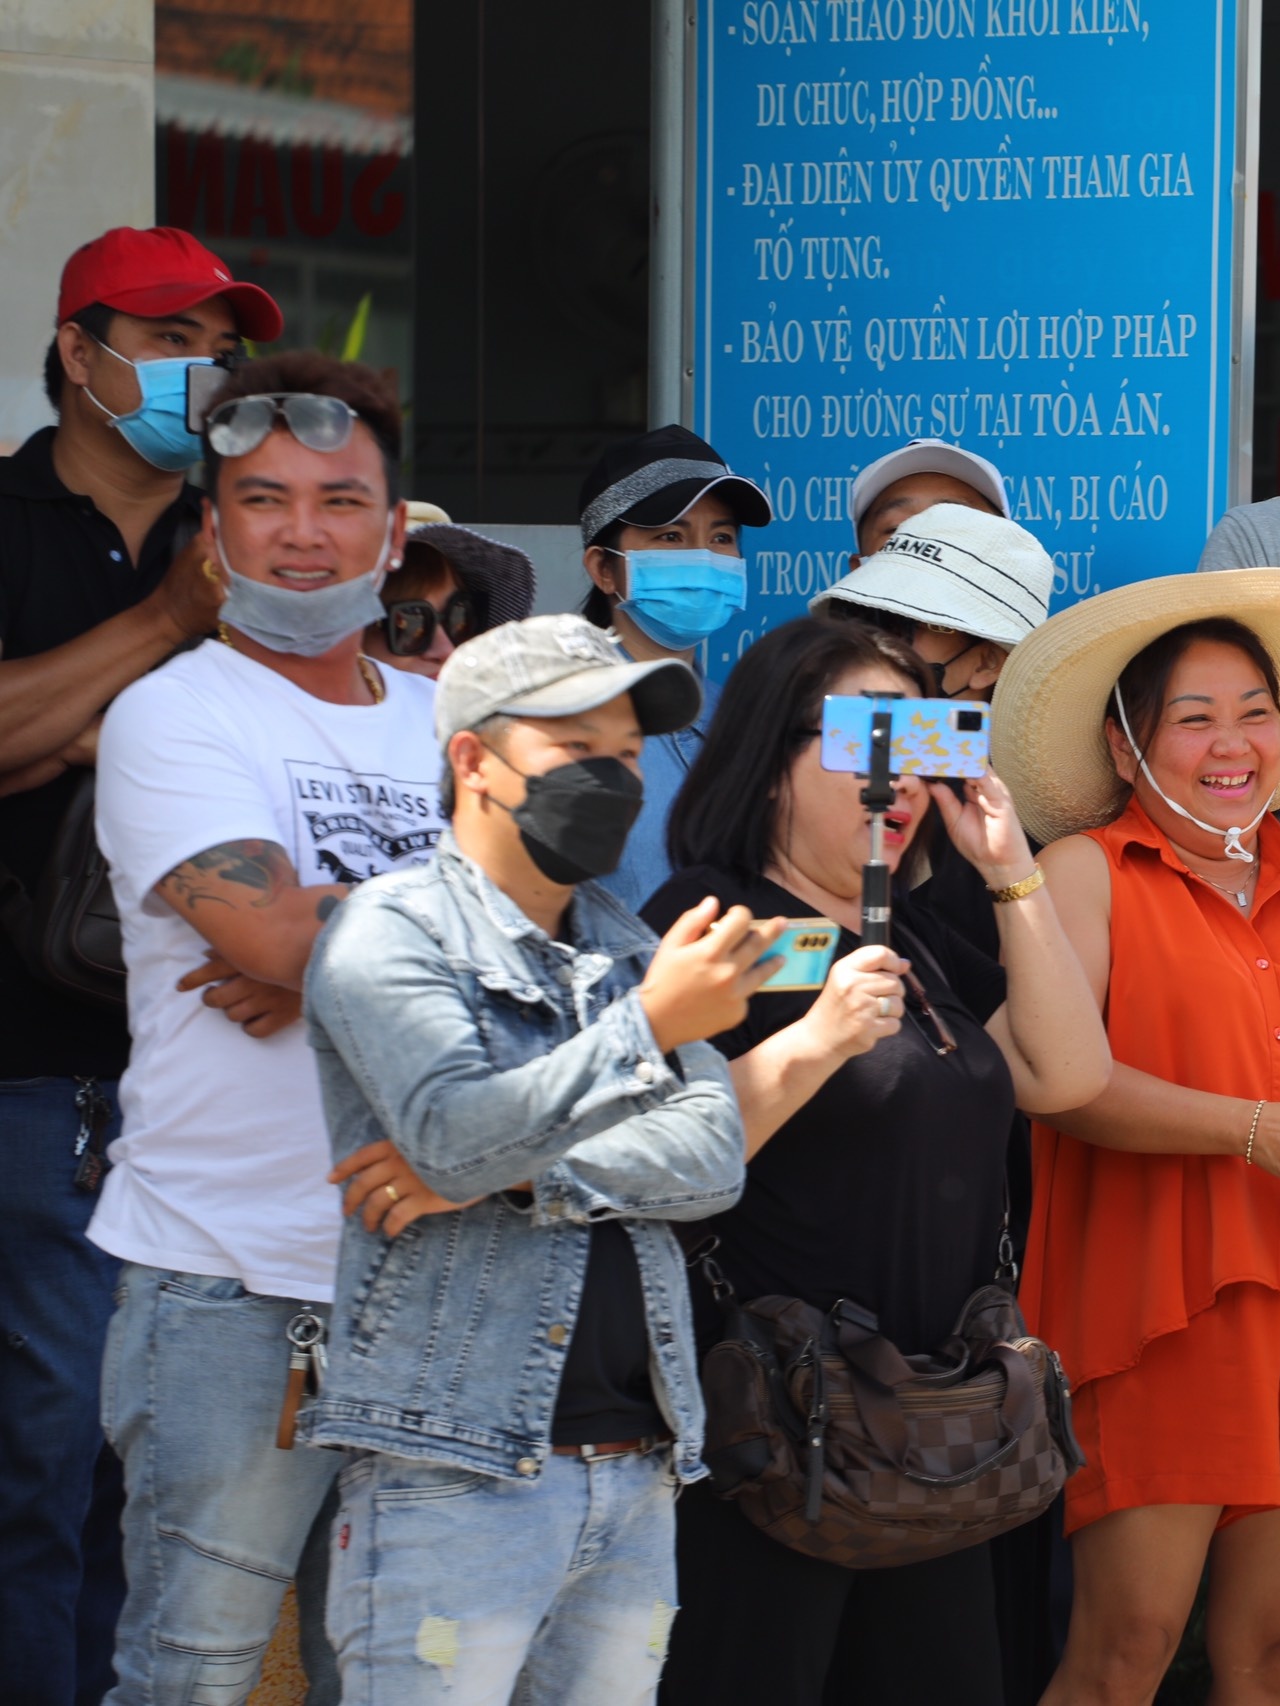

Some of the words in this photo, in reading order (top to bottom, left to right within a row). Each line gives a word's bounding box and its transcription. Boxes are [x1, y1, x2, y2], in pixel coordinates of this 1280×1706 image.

[744, 0, 818, 56] SOẠN
[757, 84, 786, 126] DI
[794, 68, 876, 132] CHÚC,
[881, 72, 944, 135] HỢP
[951, 55, 1057, 121] ĐỒNG...
[742, 163, 793, 218] ĐẠI
[801, 147, 873, 216] DIỆN
[882, 140, 922, 203] ỦY
[929, 135, 1034, 212] QUYỀN
[1043, 155, 1130, 198] THAM
[1138, 153, 1194, 197] GIA
[755, 217, 794, 280] TỐ
[801, 236, 890, 291] TỤNG.
[741, 302, 803, 362] BẢO
[811, 306, 852, 374] VỆ
[865, 296, 969, 371] QUYỀN
[978, 310, 1029, 373] LỢI
[1038, 309, 1103, 372] HỢP
[1112, 300, 1197, 358] PHÁP
[753, 395, 812, 438] CHO
[822, 389, 923, 438] ĐƯƠNG
[930, 388, 970, 448] SỰ
[975, 394, 1023, 449] TẠI
[1031, 380, 1102, 437] TÒA
[1109, 379, 1170, 436] ÁN.
[751, 462, 797, 522] ÀO
[1069, 476, 1101, 533] BỊ
[1108, 460, 1168, 521] CÁO
[878, 536, 943, 562] HANEL
[297, 778, 343, 804] LEVI
